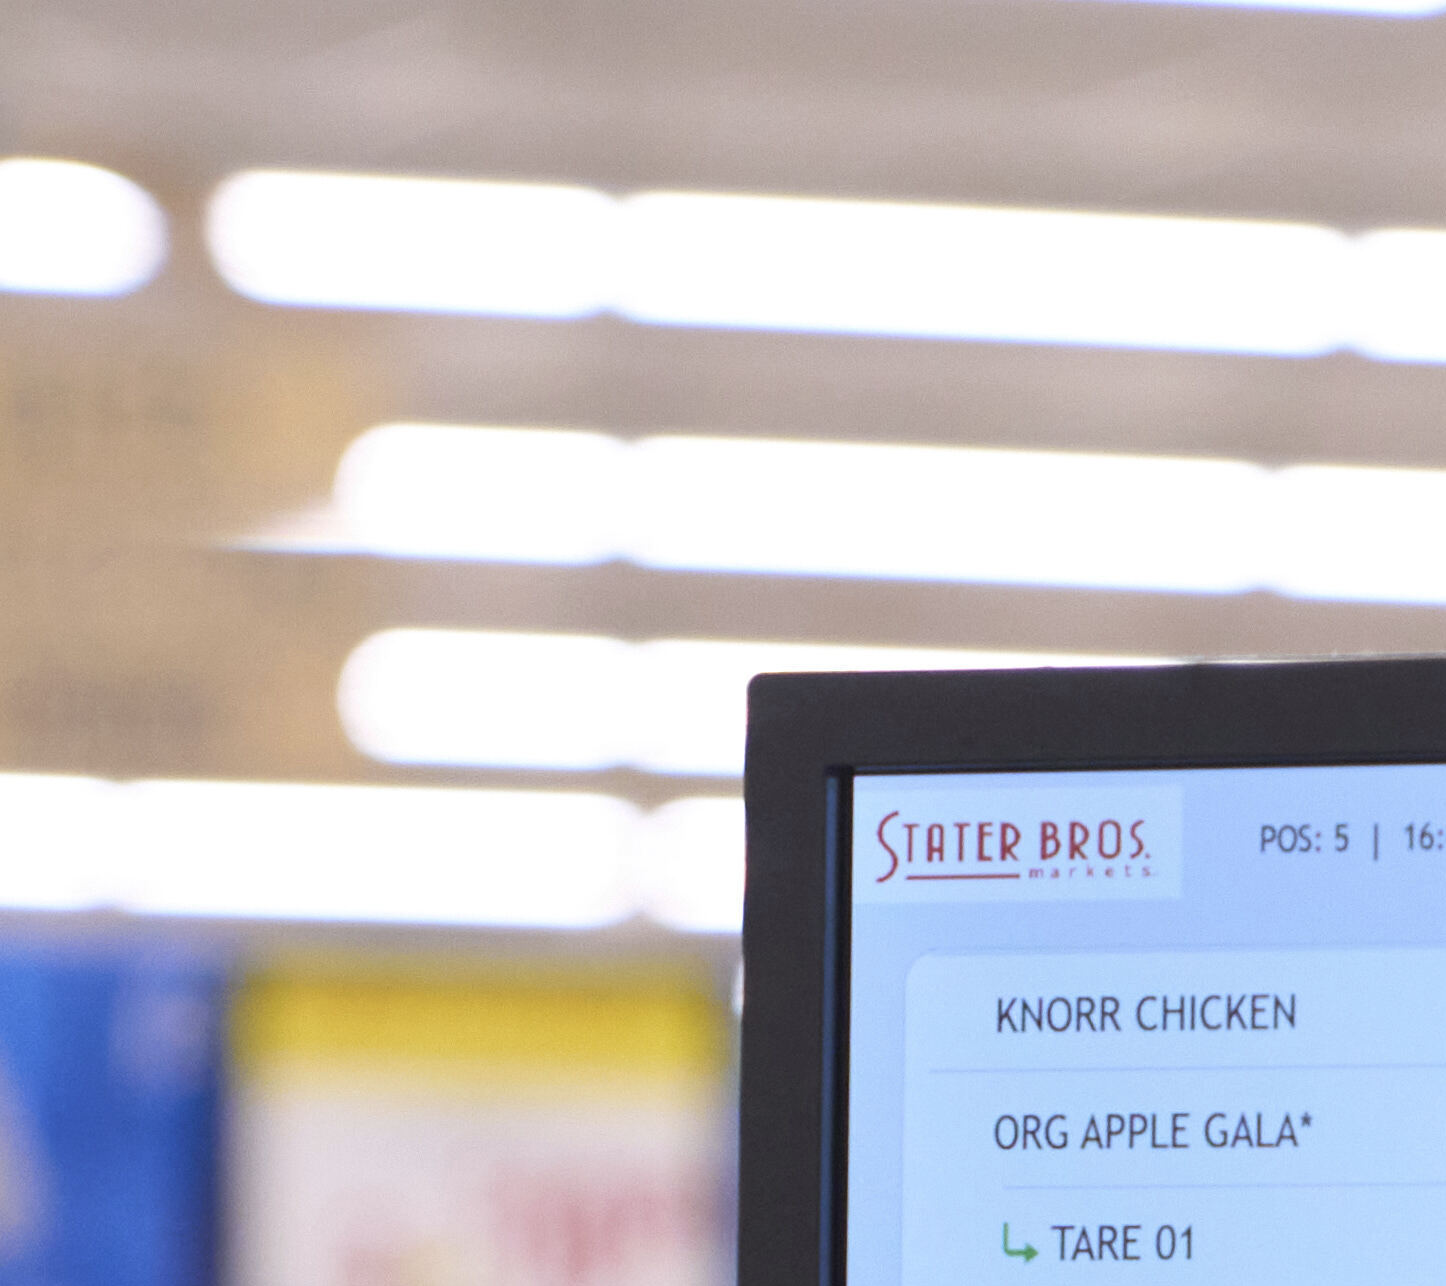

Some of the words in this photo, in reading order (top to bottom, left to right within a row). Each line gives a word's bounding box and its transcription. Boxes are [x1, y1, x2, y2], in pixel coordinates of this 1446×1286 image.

[877, 811, 1021, 883] STATER
[1040, 820, 1149, 860] BROS.
[1260, 824, 1321, 853] POS:
[1335, 823, 1349, 852] 5
[997, 996, 1121, 1032] KNORR
[1136, 994, 1295, 1031] CHICKEN
[994, 1114, 1068, 1150] ORG
[1081, 1113, 1189, 1149] APPLE
[1052, 1225, 1141, 1261] TARE
[1156, 1225, 1192, 1260] 01
